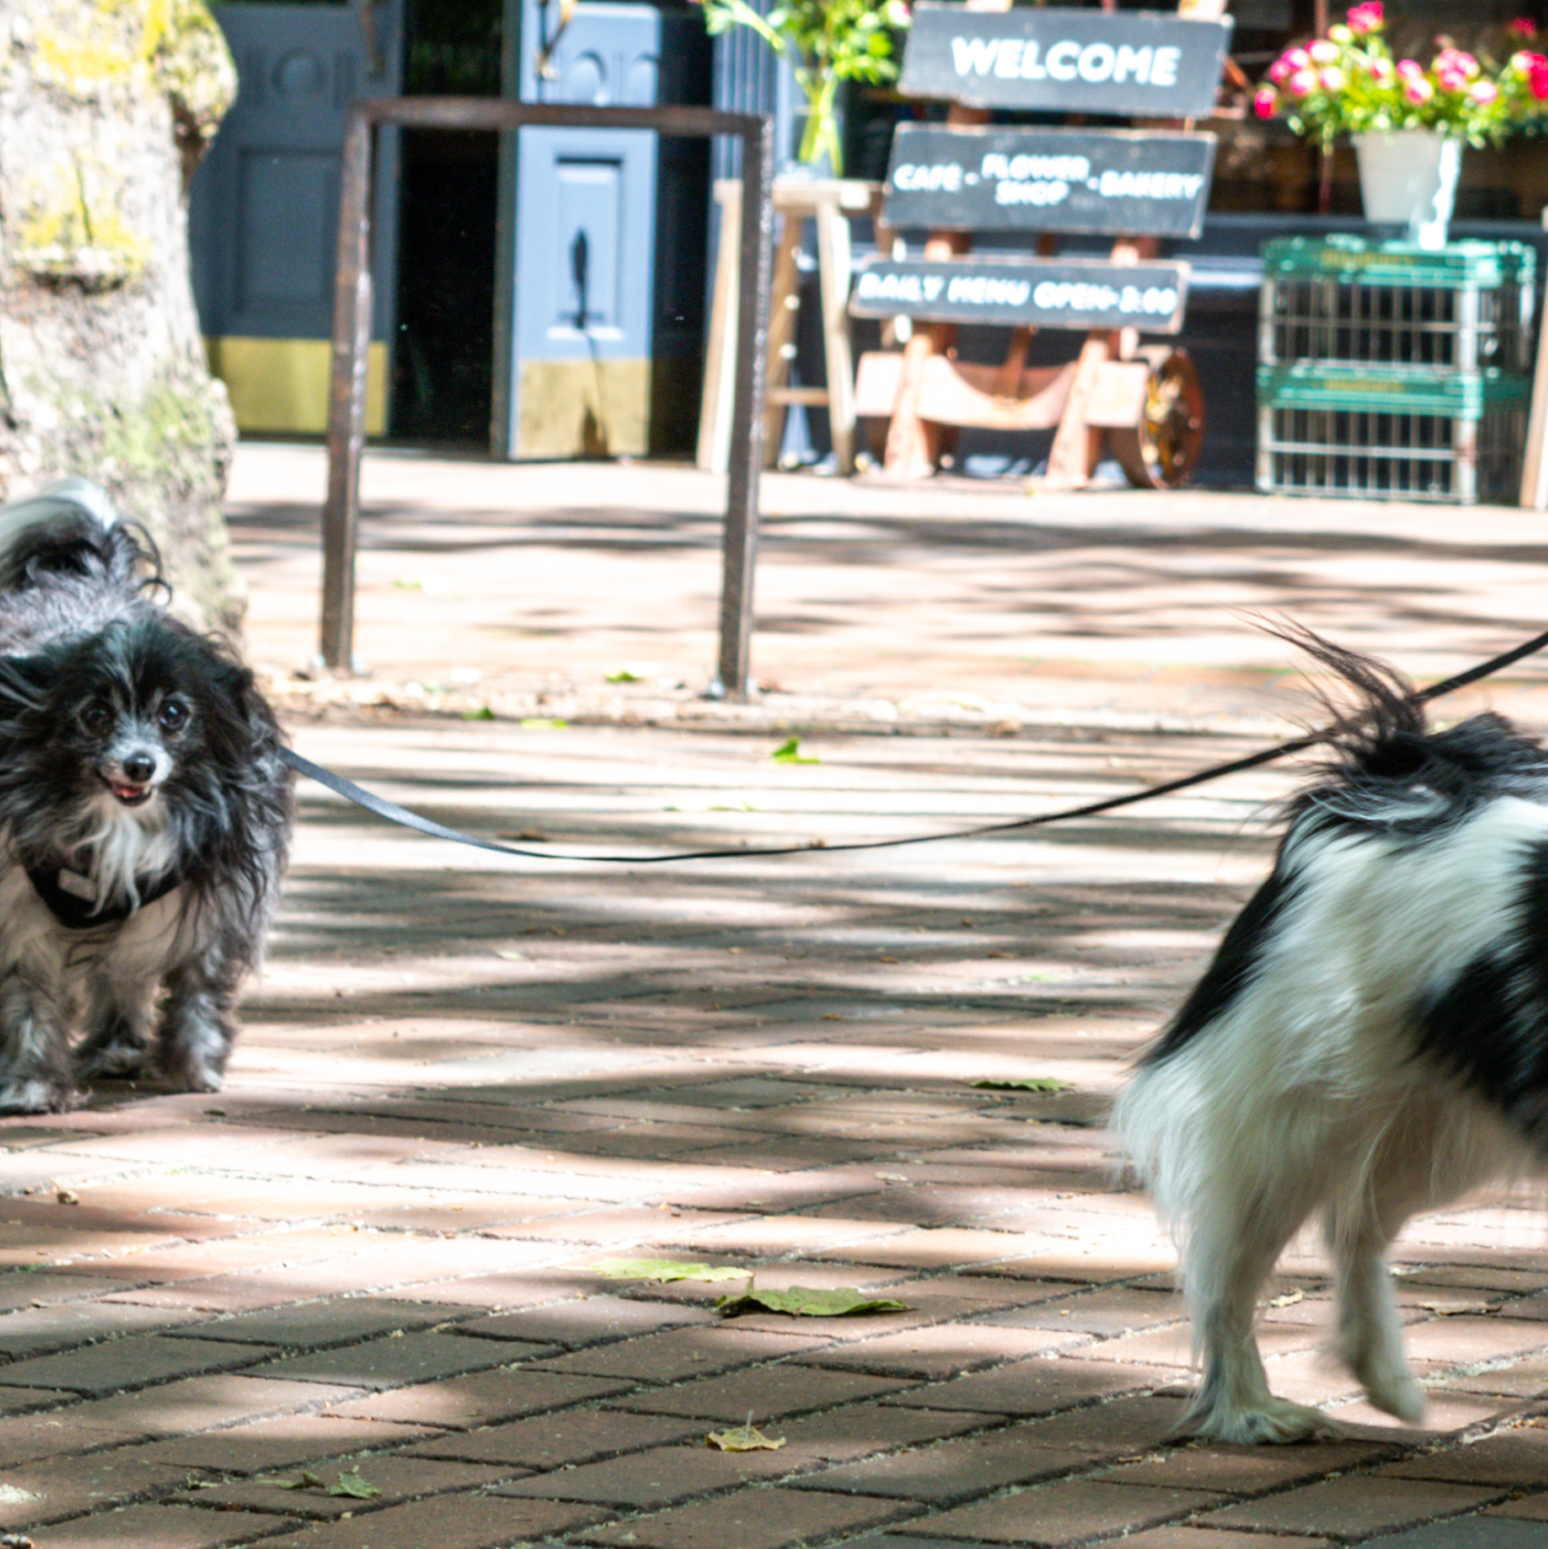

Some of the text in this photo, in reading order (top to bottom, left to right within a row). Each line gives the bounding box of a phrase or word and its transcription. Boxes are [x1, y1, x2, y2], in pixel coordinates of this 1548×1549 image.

[951, 36, 1182, 87] WELCOME
[981, 153, 1091, 181] FLOWER
[995, 180, 1070, 206] SHOP
[1099, 170, 1204, 199] BAKERY
[857, 271, 945, 302] DAILY
[947, 276, 1032, 307] MENU
